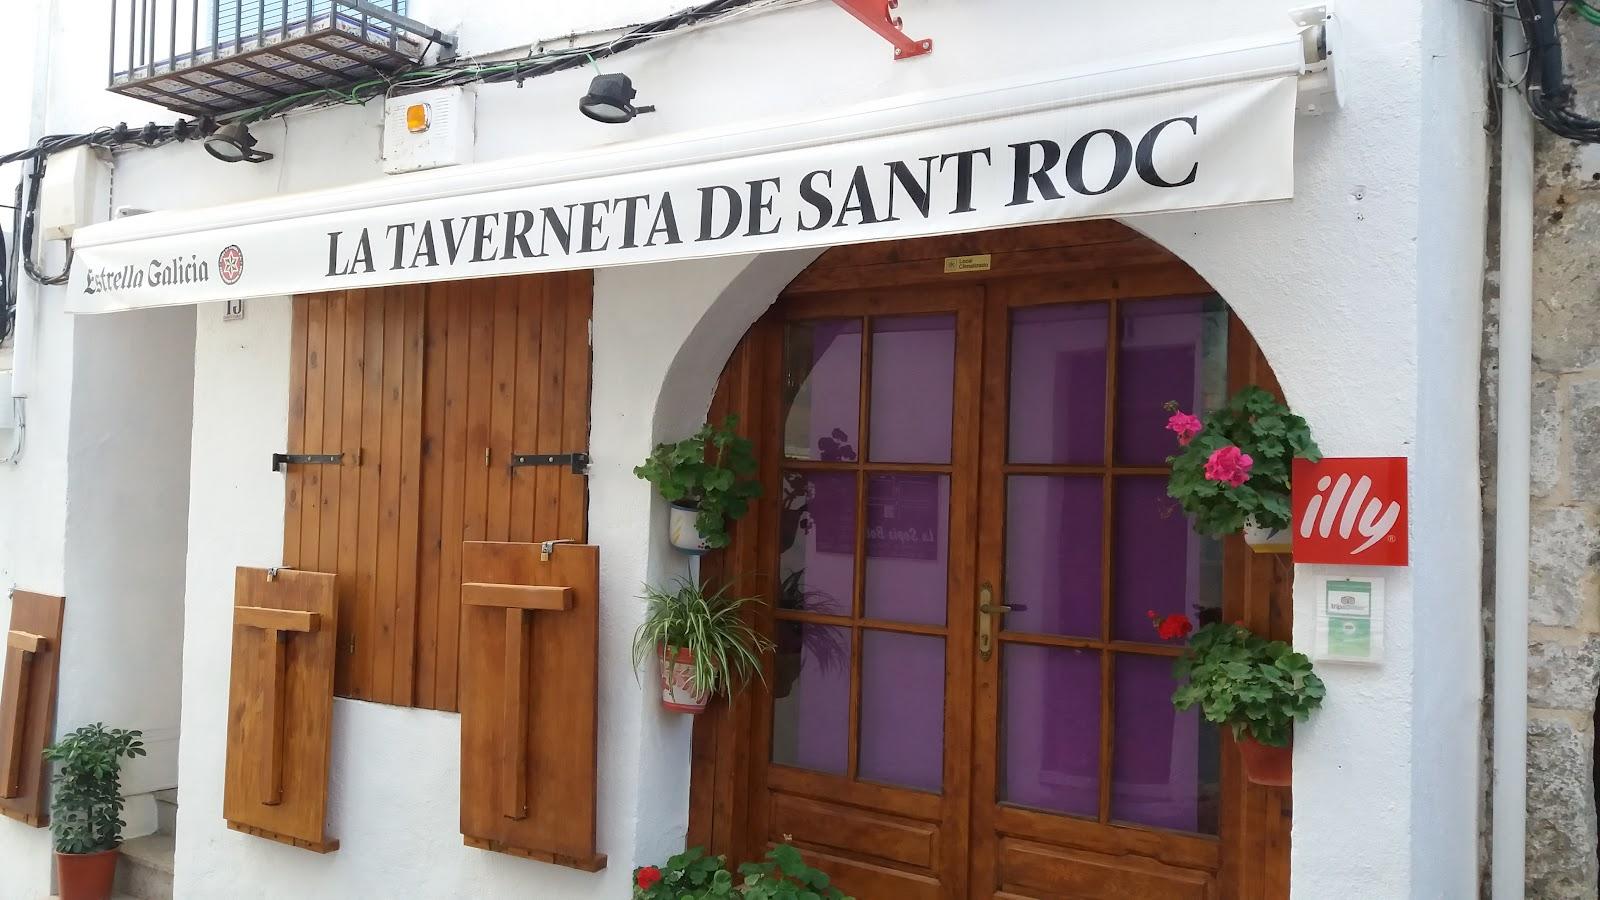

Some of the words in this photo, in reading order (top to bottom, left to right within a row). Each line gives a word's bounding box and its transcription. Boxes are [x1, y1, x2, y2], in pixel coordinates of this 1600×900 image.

[325, 228, 376, 277] LA
[385, 191, 682, 270] TAVERNETA
[694, 177, 783, 242] DE
[797, 146, 992, 232] SANT
[1004, 115, 1199, 207] ROC
[83, 265, 144, 295] Estrella
[148, 254, 209, 287] Galicia
[1300, 473, 1401, 555] illy
